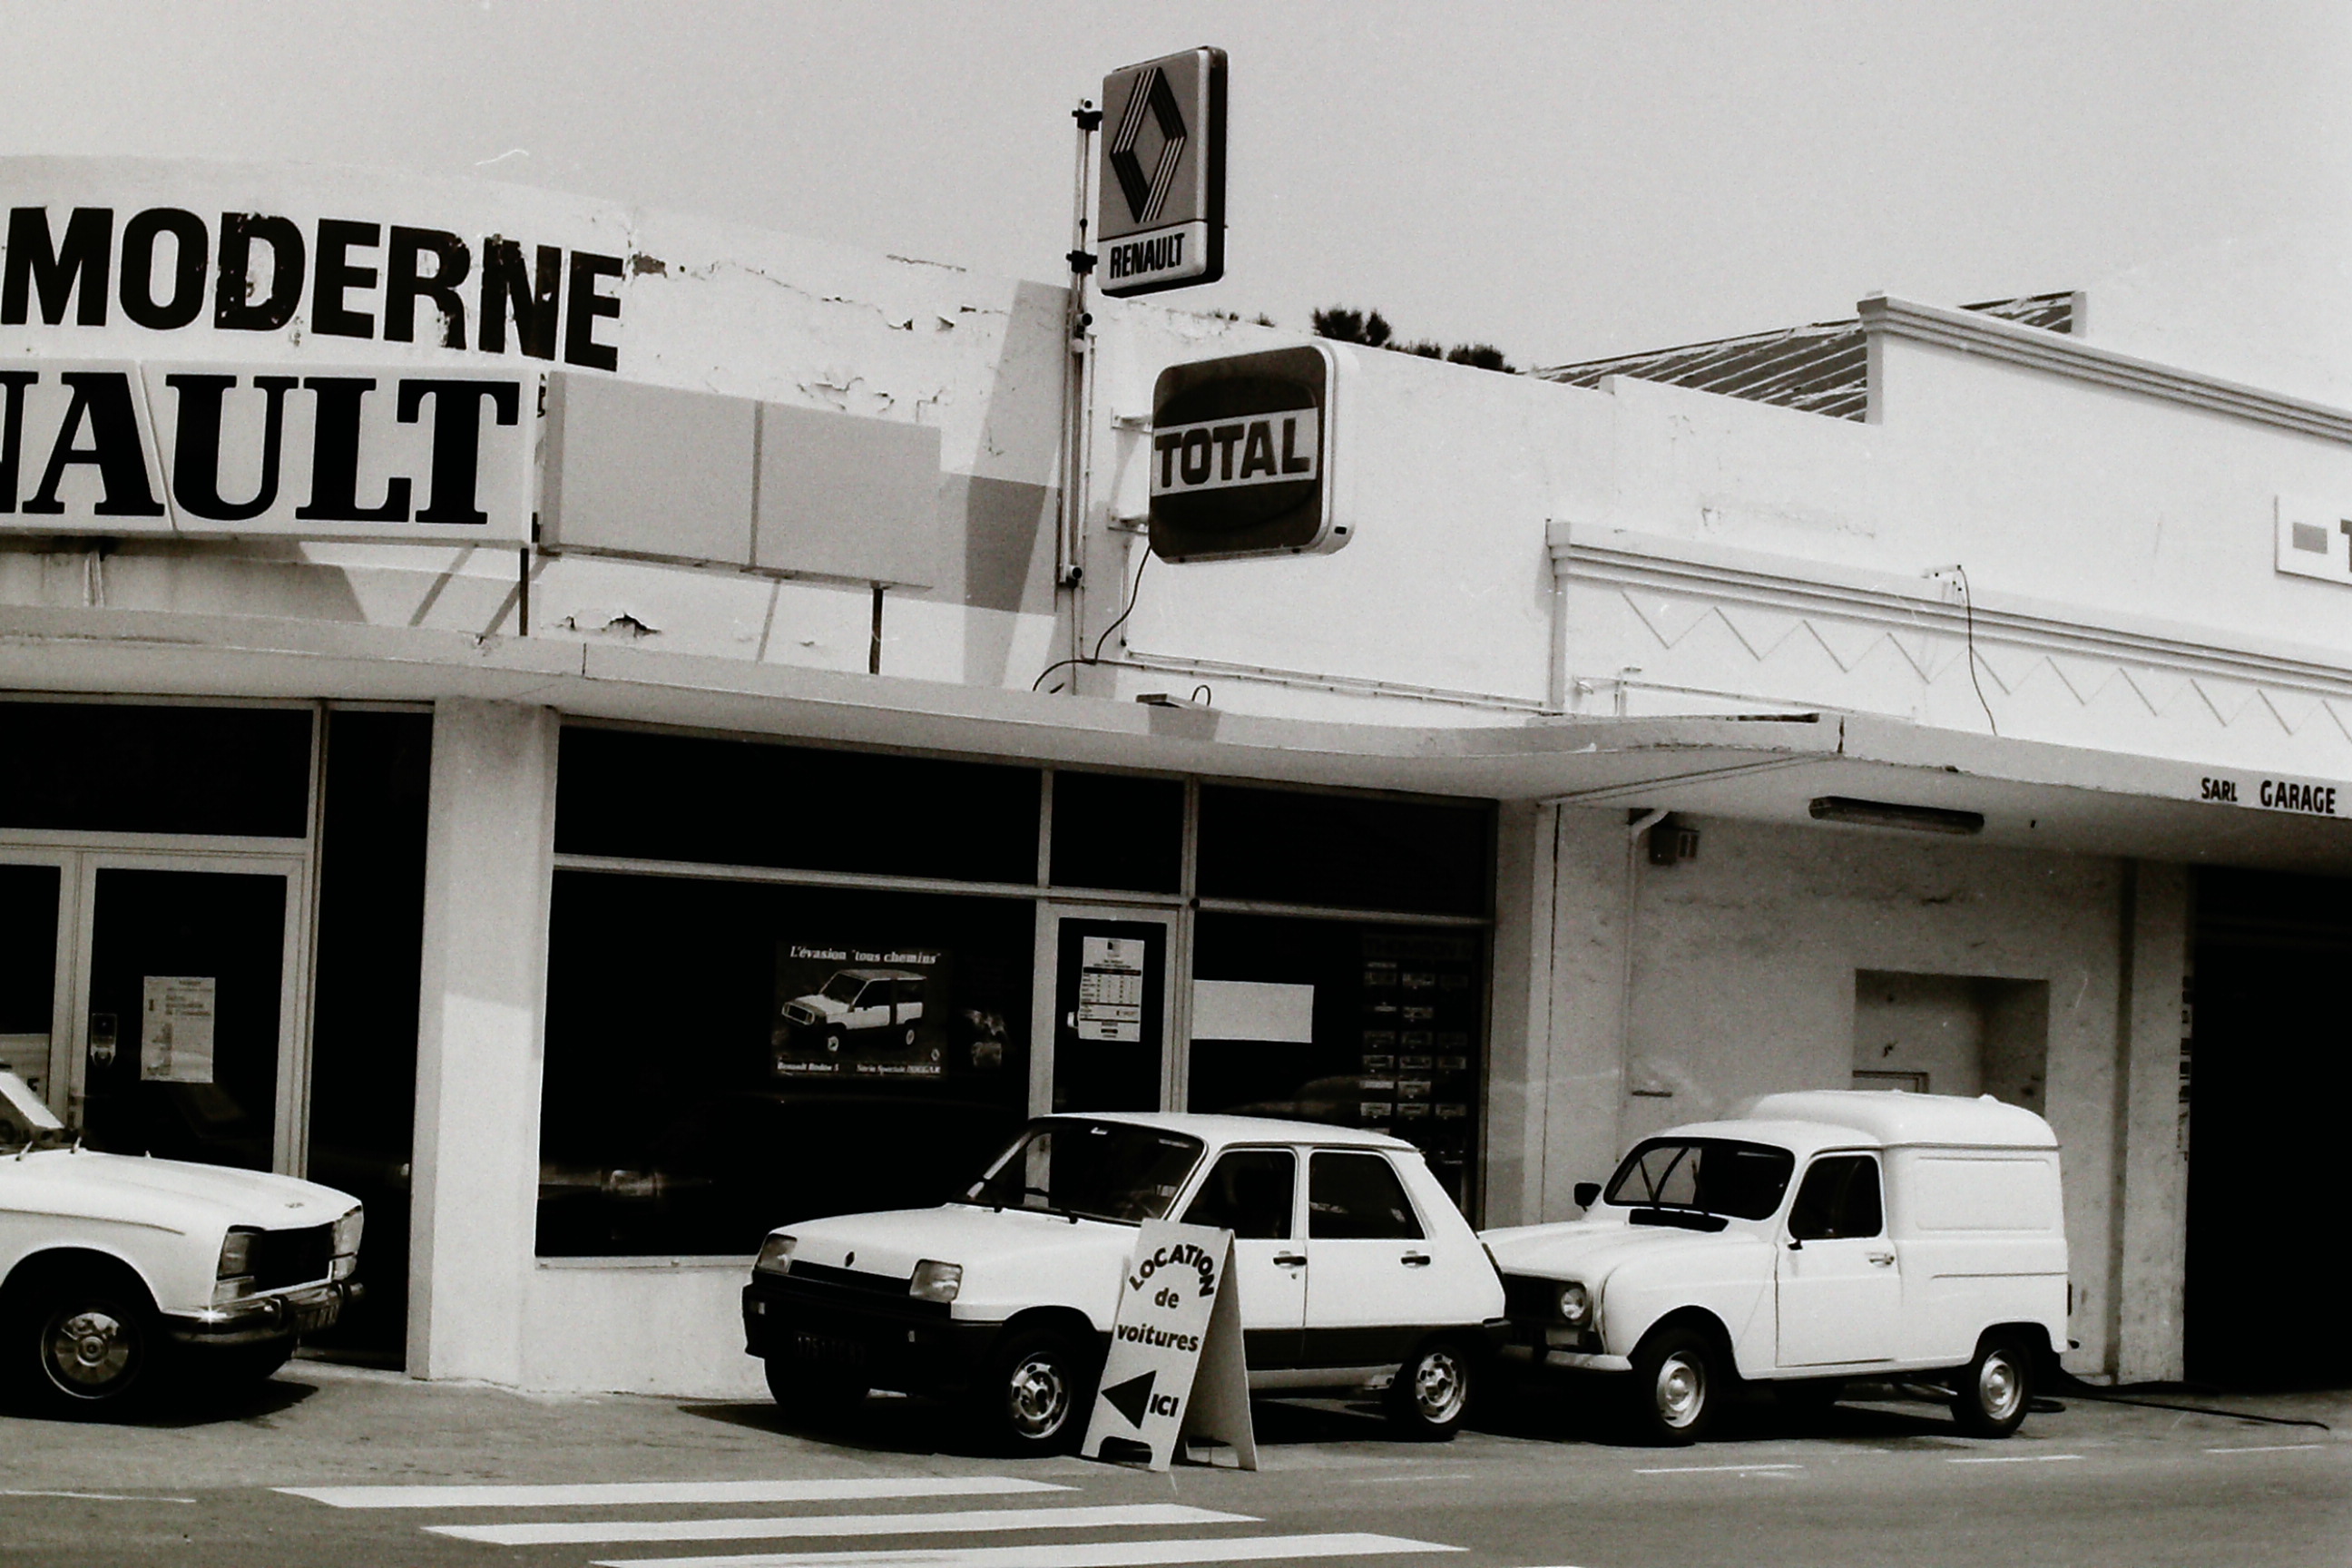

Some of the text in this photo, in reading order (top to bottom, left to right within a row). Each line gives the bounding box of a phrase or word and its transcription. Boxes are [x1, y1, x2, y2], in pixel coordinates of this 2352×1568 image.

[1109, 232, 1186, 279] RENAULT
[0, 205, 624, 372] MODERNE
[0, 370, 520, 524] AULT
[1154, 417, 1311, 489] TOTAL
[2200, 777, 2337, 815] SARL GARAGE
[1129, 1244, 1215, 1298] LOCATION
[1154, 1287, 1180, 1308] de
[1117, 1324, 1199, 1352] voitures
[1149, 1394, 1180, 1417] ICI
